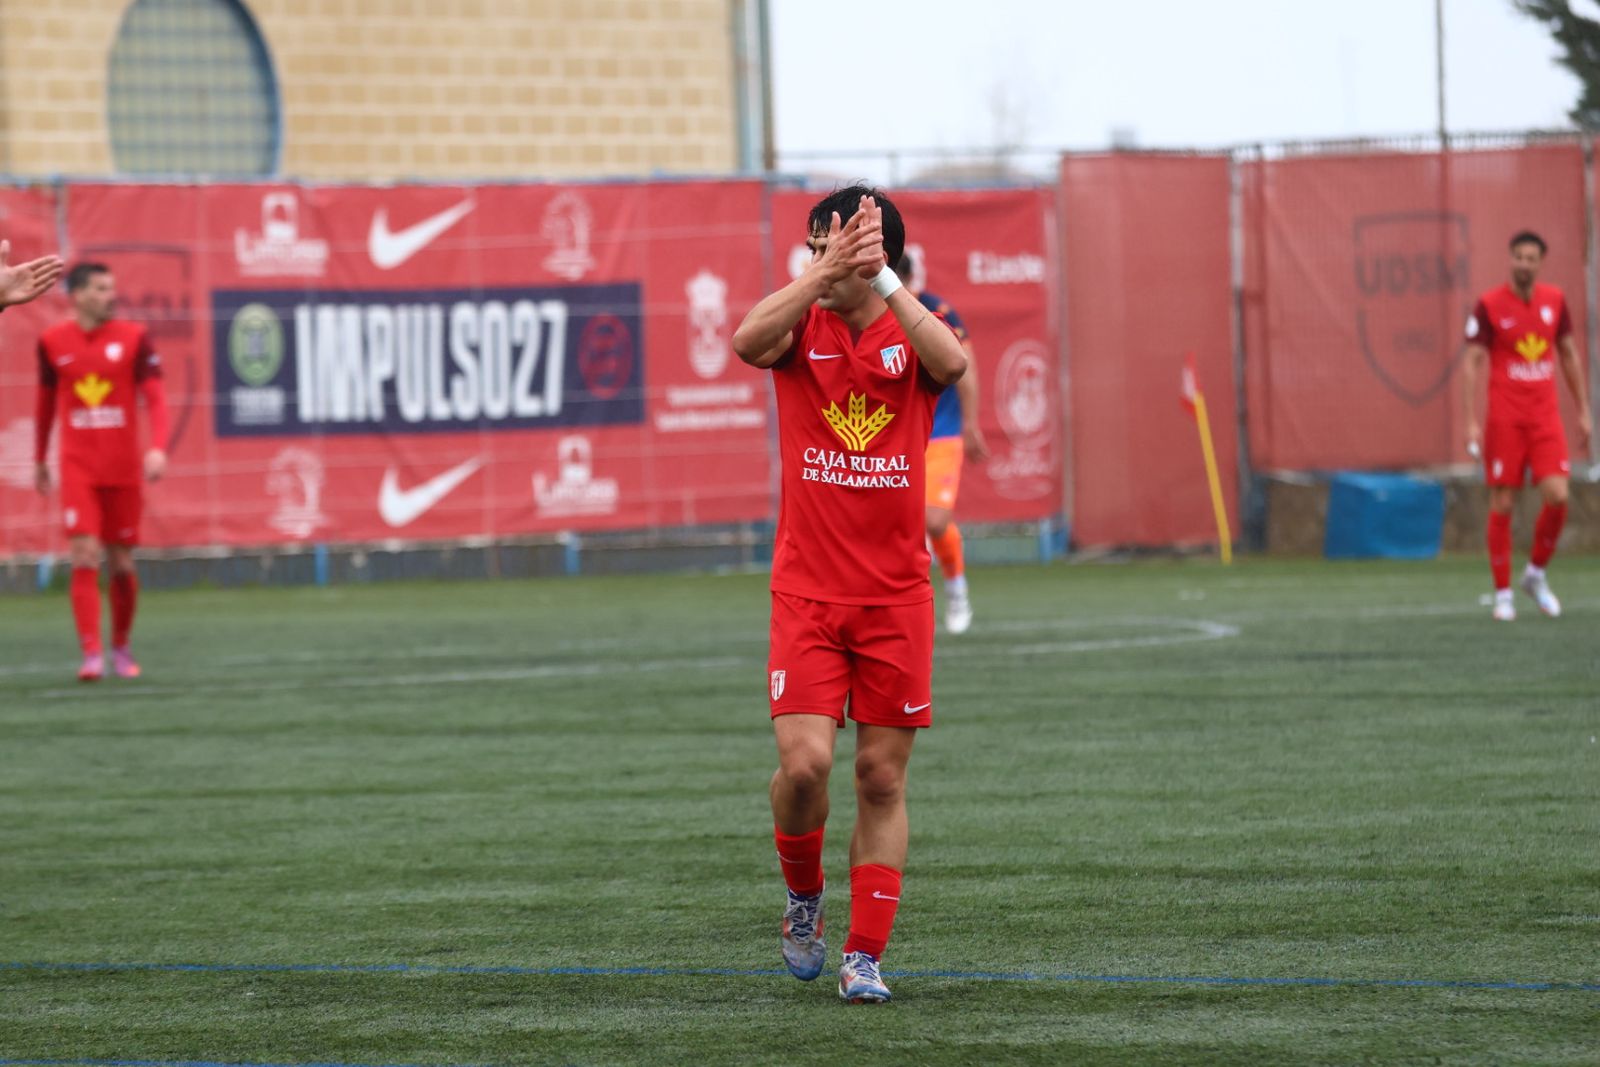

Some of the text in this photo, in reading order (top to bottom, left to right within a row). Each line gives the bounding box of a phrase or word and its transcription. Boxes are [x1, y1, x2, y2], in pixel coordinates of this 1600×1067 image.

[1354, 253, 1470, 297] UDSM
[295, 301, 567, 422] IMPULSO27
[803, 447, 910, 472] CAJA RURAL
[802, 467, 910, 488] DE SALAMANCA
